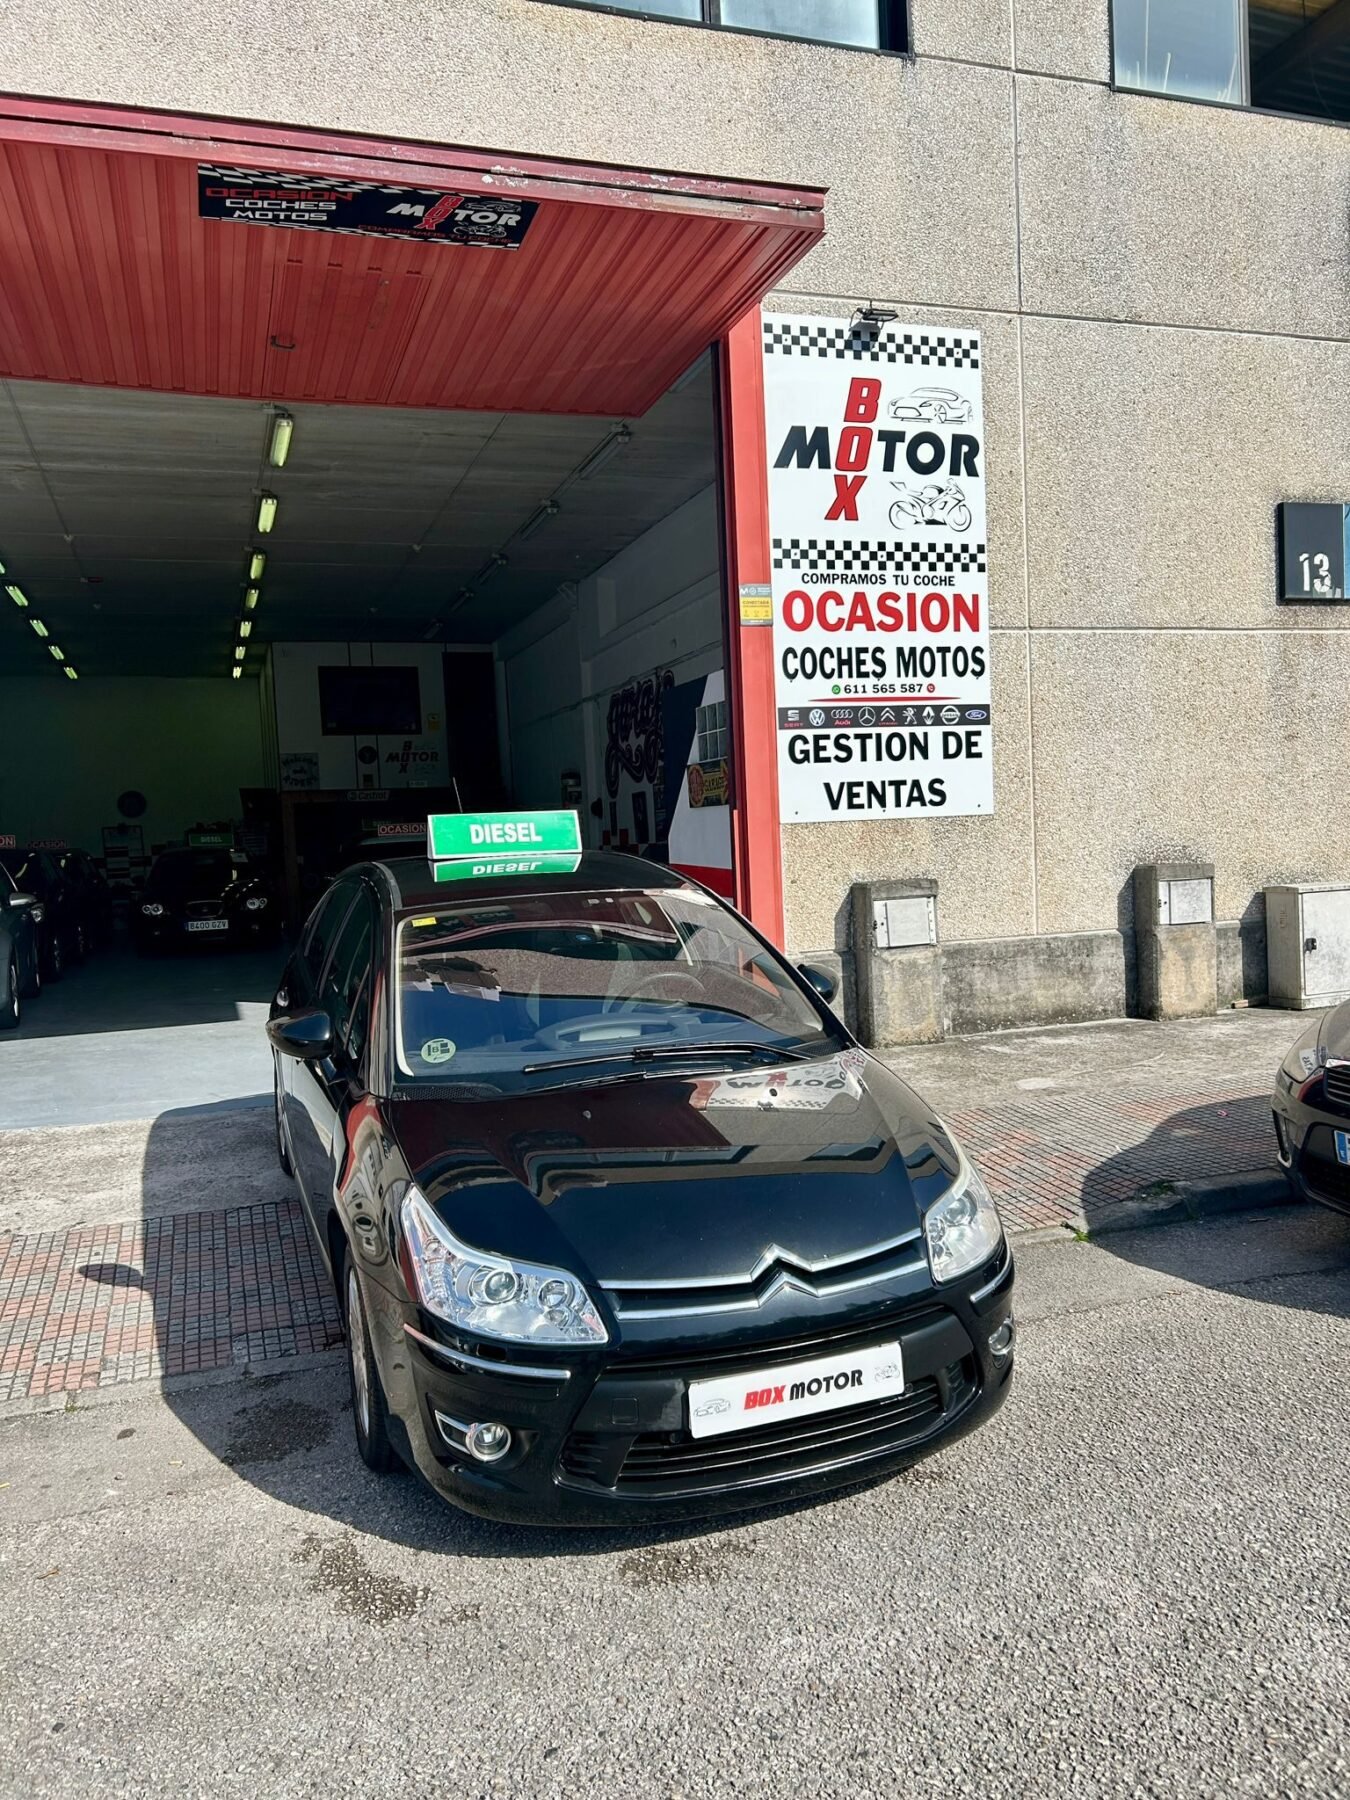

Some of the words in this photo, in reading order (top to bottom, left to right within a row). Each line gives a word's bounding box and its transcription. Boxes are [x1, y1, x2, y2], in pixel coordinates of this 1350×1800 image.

[206, 187, 354, 202] OCASION
[225, 199, 337, 211] COCHES
[233, 210, 328, 221] MOTOS
[773, 425, 980, 478] MOTOR
[824, 377, 882, 522] BOX
[801, 572, 887, 586] COMPRAMOS
[893, 574, 909, 585] TU
[914, 575, 956, 587] COCHE
[782, 590, 980, 633] OCASION
[782, 646, 887, 680] COCHES
[896, 646, 986, 679] MOTOS
[844, 684, 867, 694] 611
[872, 684, 897, 693] 565
[900, 683, 923, 693] 587
[788, 732, 929, 765] GESTION
[942, 731, 983, 760] DE
[823, 778, 947, 811] VENTAS
[469, 822, 543, 845] DIESEL
[743, 1385, 787, 1411] BOX
[789, 1368, 864, 1402] MOTOR
